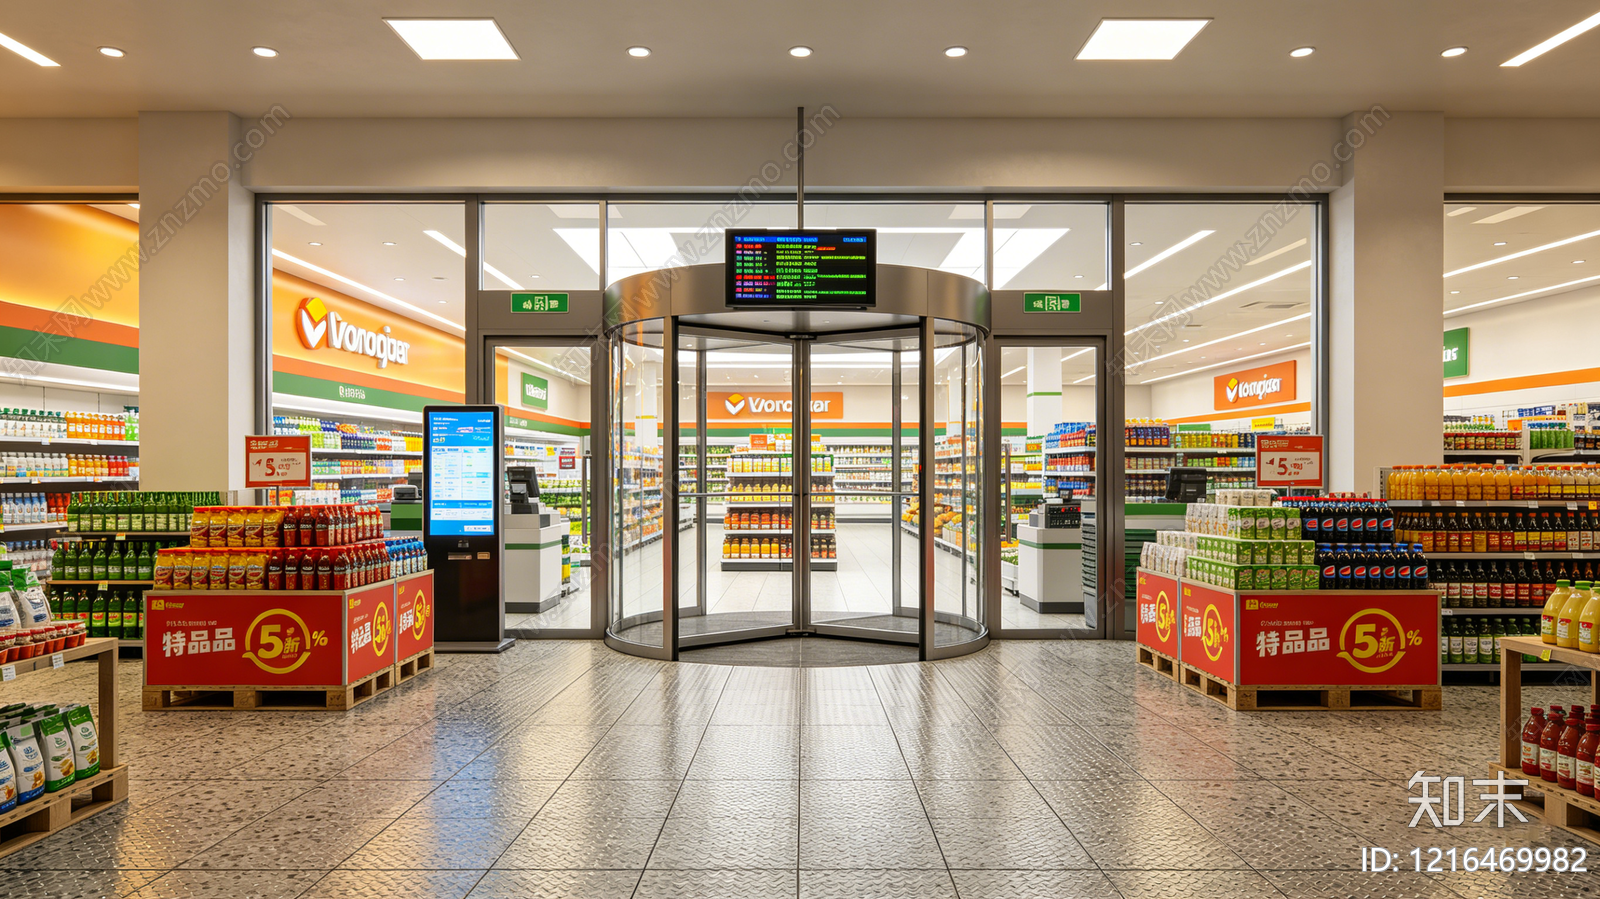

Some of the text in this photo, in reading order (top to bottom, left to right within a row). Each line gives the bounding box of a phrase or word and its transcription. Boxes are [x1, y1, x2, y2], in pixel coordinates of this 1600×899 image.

[162, 627, 236, 658] 特品品
[1255, 627, 1331, 658] 特品品
